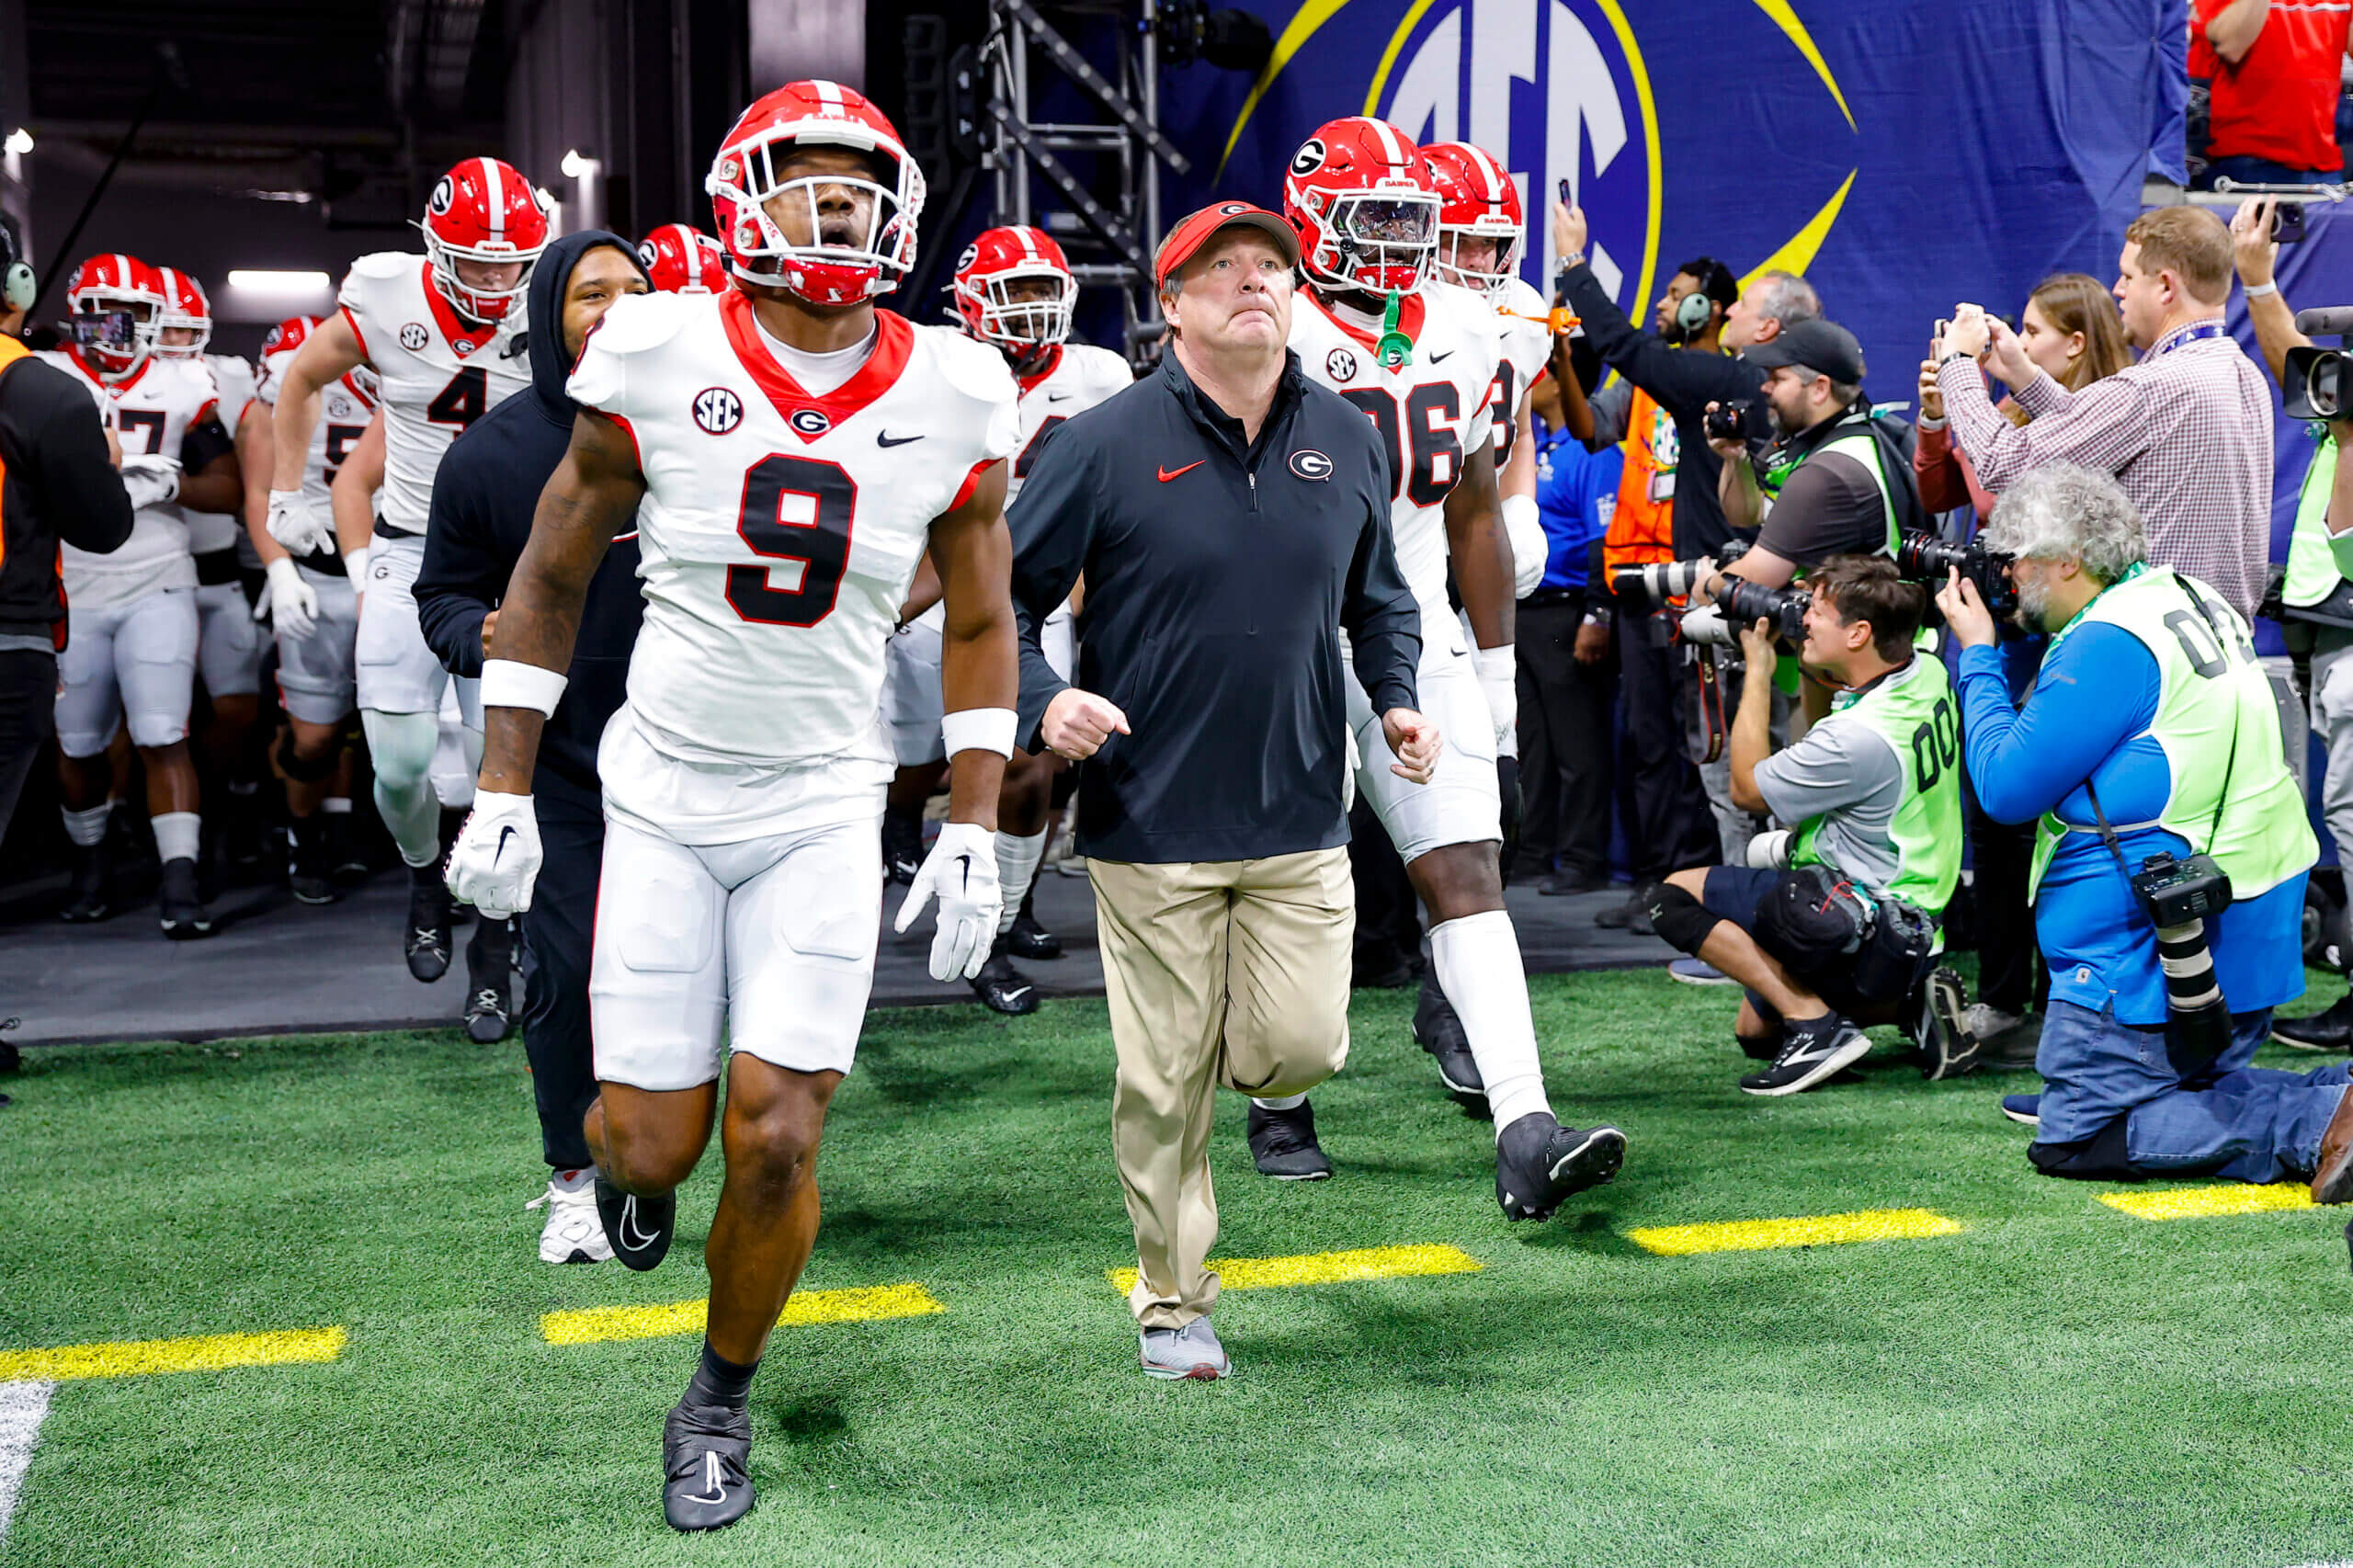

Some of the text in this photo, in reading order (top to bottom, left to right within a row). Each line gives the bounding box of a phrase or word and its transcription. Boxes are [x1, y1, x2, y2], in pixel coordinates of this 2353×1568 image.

[1291, 140, 1325, 176] G
[402, 324, 428, 351] SEC
[1327, 349, 1356, 382] SEC
[428, 366, 487, 440] 4
[694, 388, 744, 435] SEC
[106, 410, 166, 454] 7
[792, 410, 829, 433] G
[1292, 451, 1333, 479] G
[725, 452, 858, 628] 9
[375, 566, 388, 579] G
[1913, 697, 1959, 794] 00
